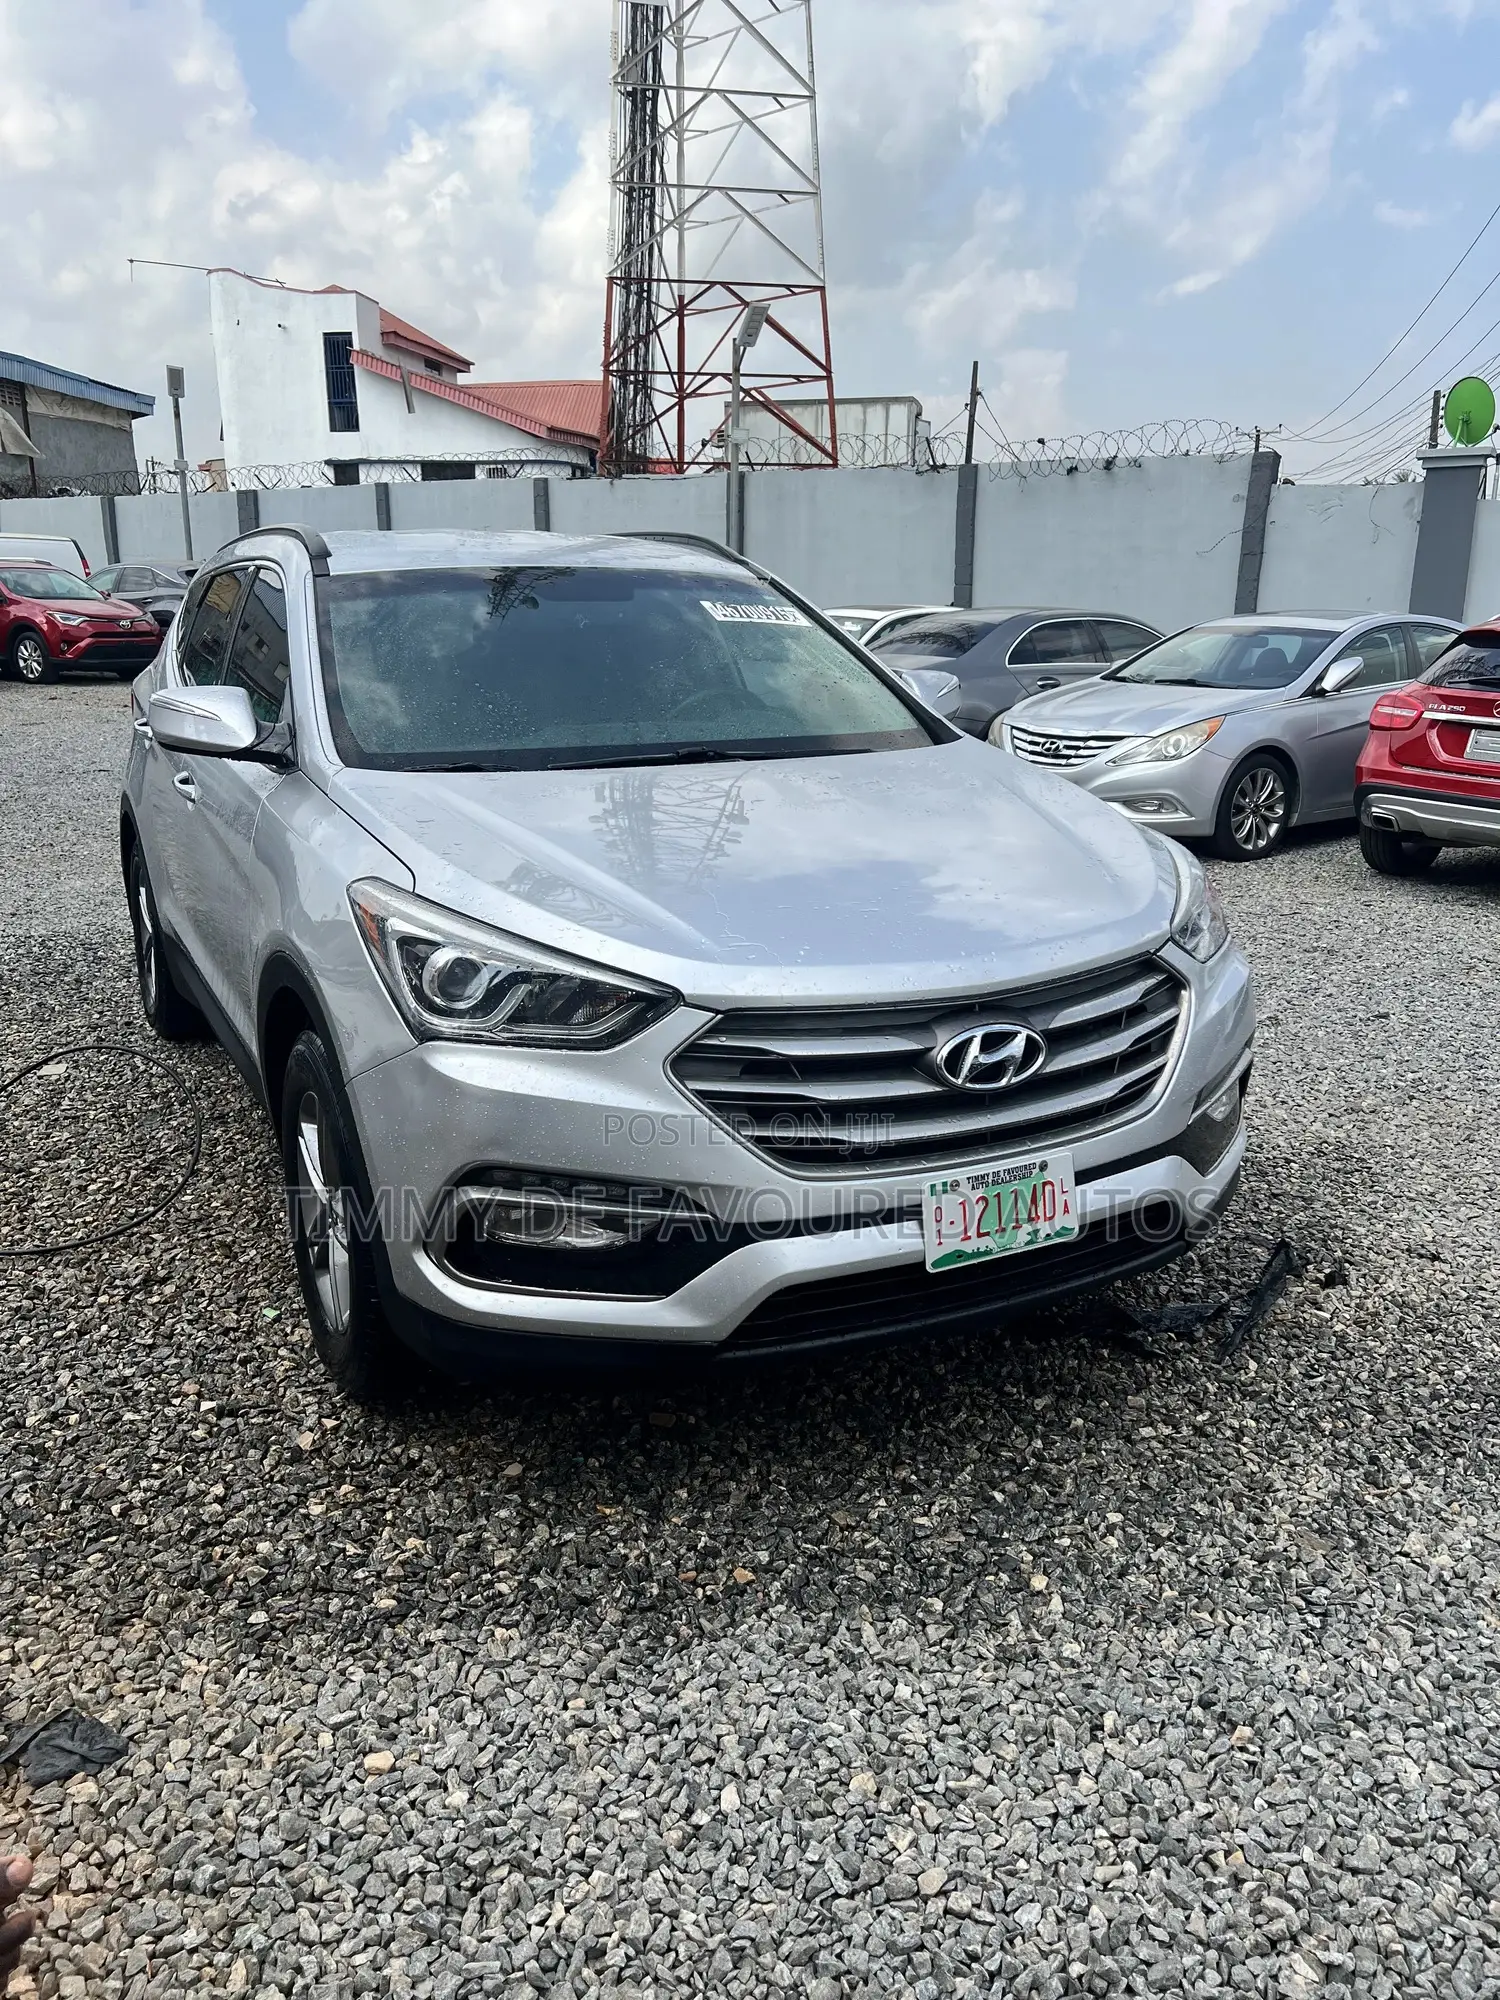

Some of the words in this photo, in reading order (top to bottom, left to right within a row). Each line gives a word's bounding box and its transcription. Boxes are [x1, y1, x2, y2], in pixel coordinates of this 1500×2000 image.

[966, 1173, 990, 1184] TIMMY
[991, 1169, 1001, 1179] DE
[1003, 1163, 1036, 1176] FAVOURED
[970, 1180, 990, 1191] AUTO
[991, 1171, 1033, 1185] DEALERSHIP
